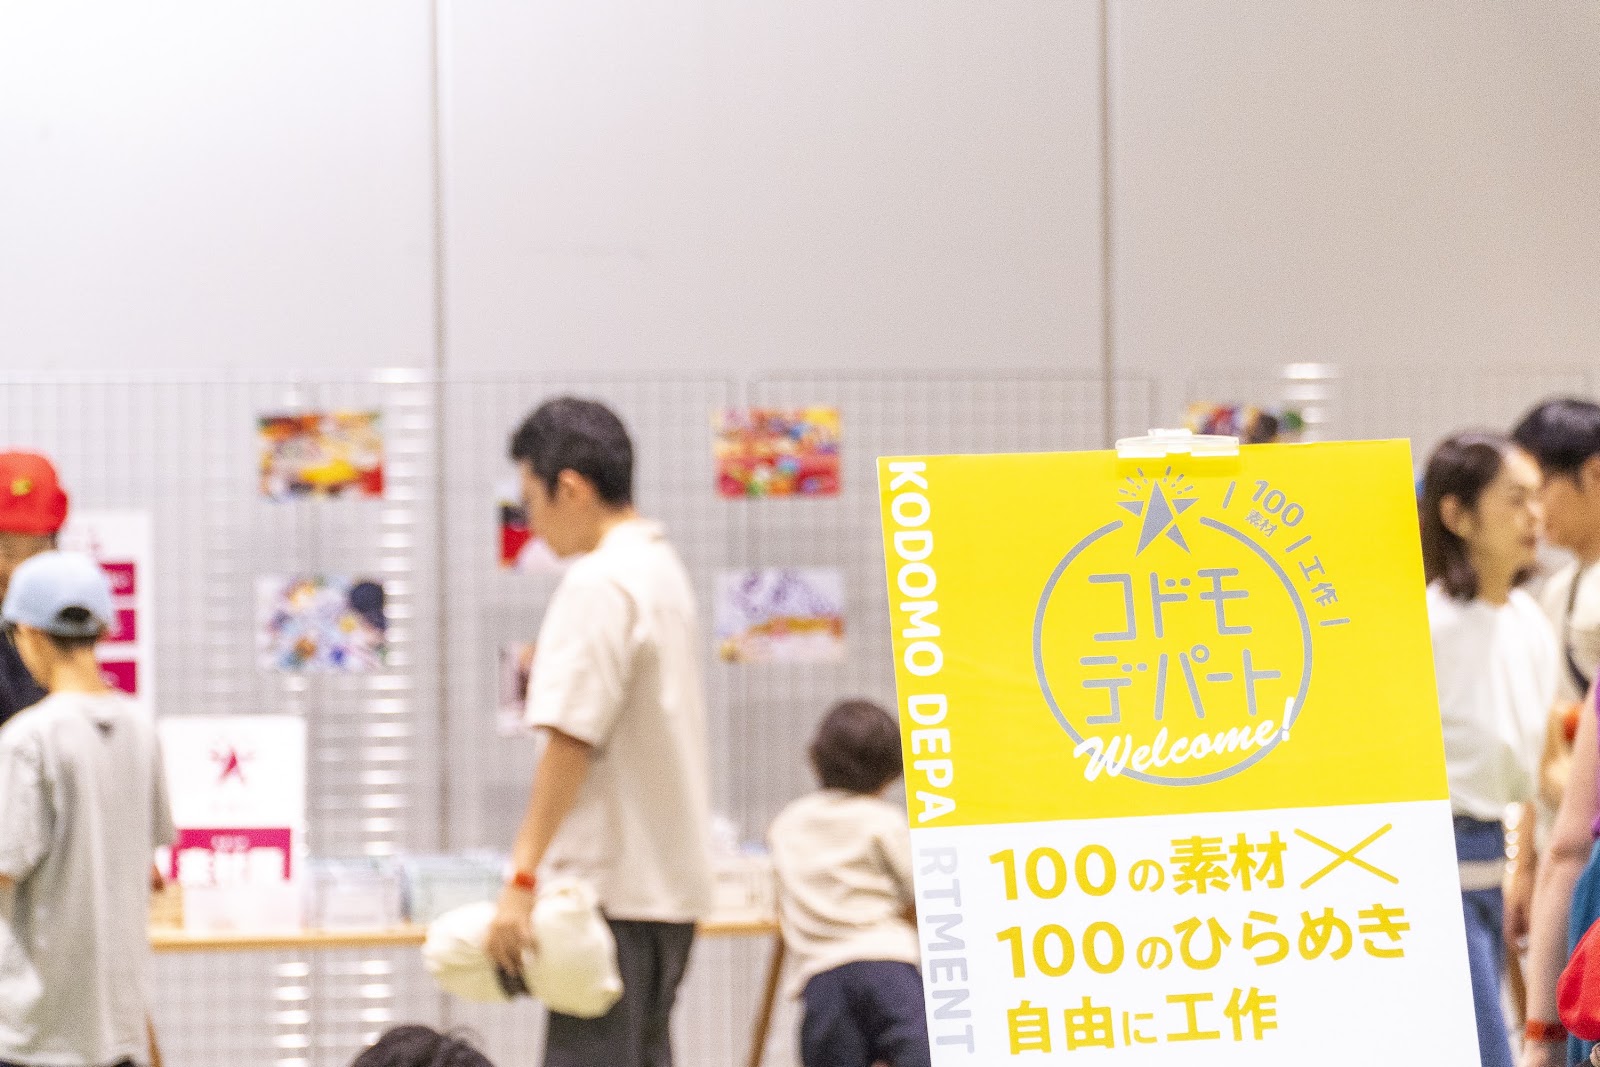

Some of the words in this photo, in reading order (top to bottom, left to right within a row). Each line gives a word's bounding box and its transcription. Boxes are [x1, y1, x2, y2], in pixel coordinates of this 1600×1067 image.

[1244, 508, 1278, 538] 素材
[1251, 479, 1305, 528] 100
[889, 461, 944, 677] KODOMO
[1087, 567, 1254, 642] コドモ
[1298, 555, 1339, 607] 工作
[1079, 644, 1281, 725] デパート
[1073, 696, 1297, 782] Welcome!
[1007, 987, 1278, 1055] 自由に工作
